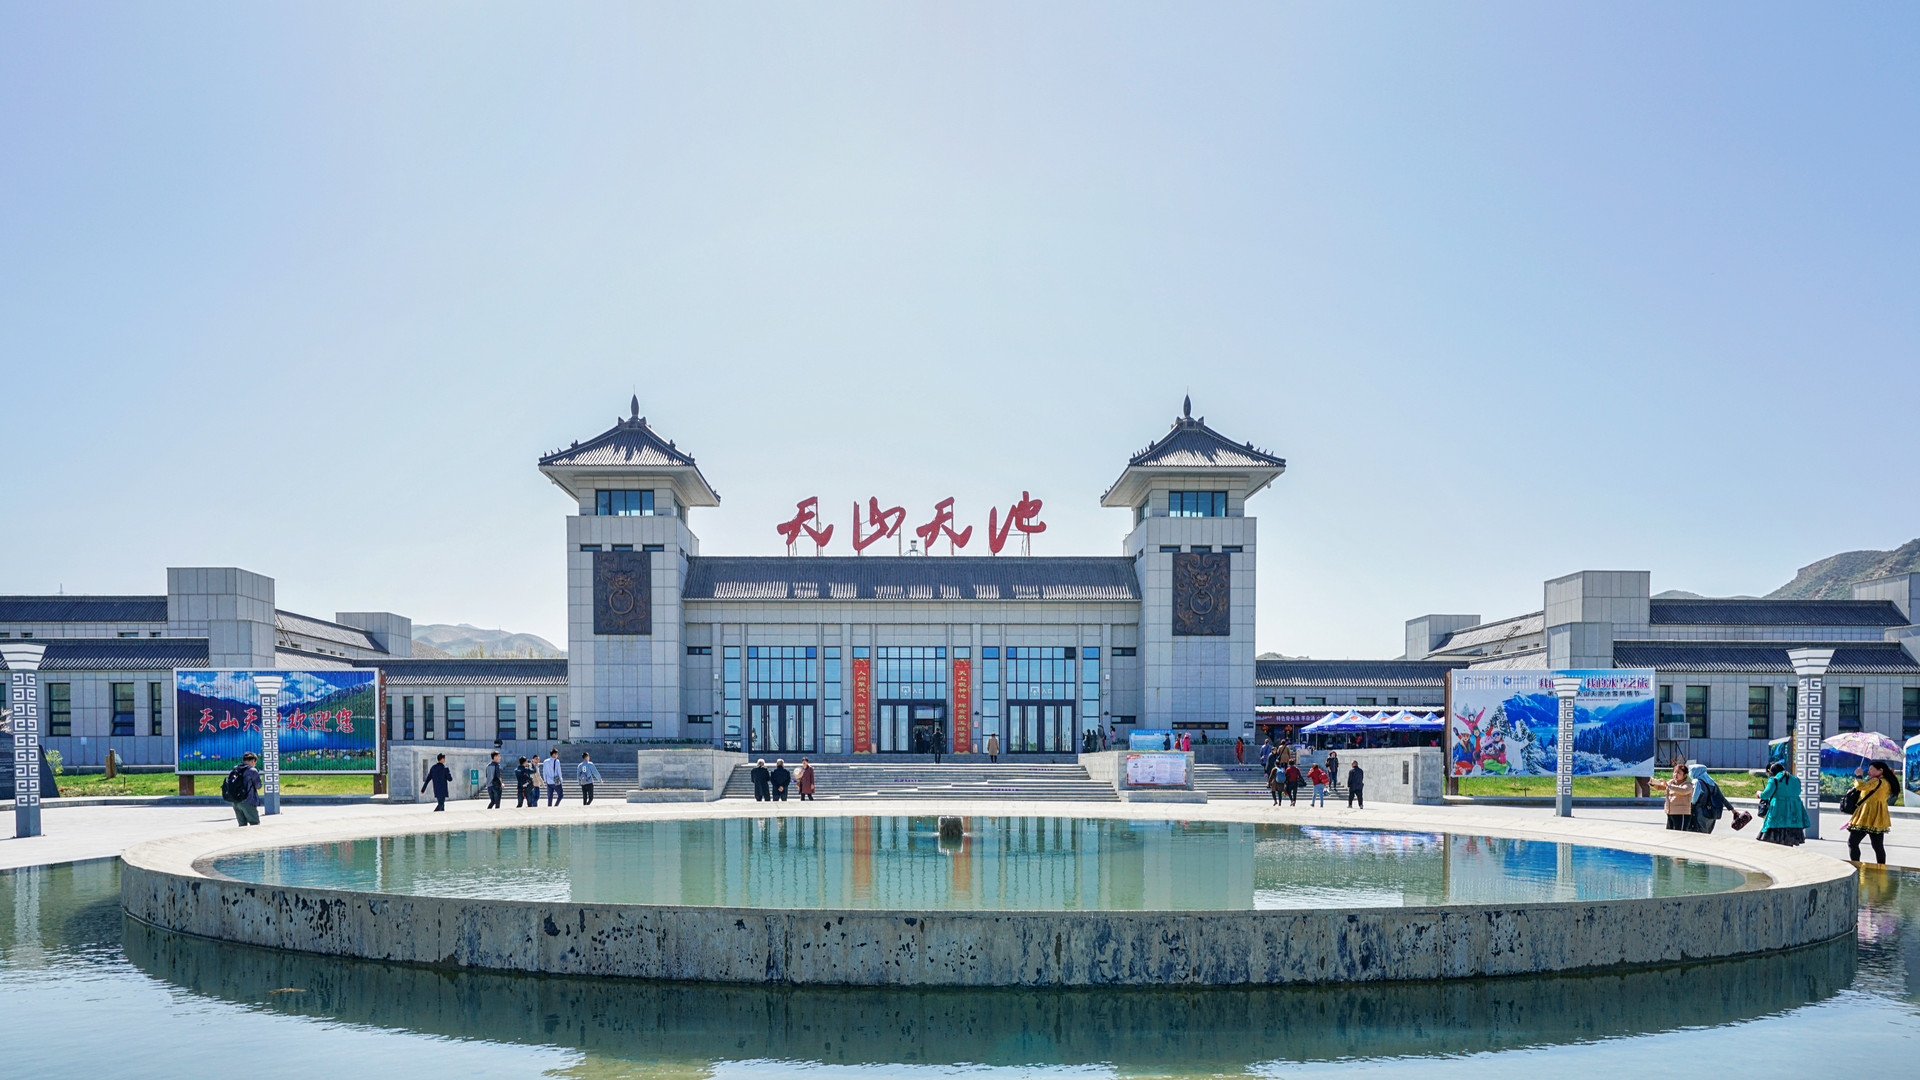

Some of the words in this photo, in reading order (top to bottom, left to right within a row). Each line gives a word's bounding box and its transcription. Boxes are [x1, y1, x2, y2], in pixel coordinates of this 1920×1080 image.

[777, 491, 1047, 554] 天山天池
[199, 708, 356, 733] 天山天欢迎您
